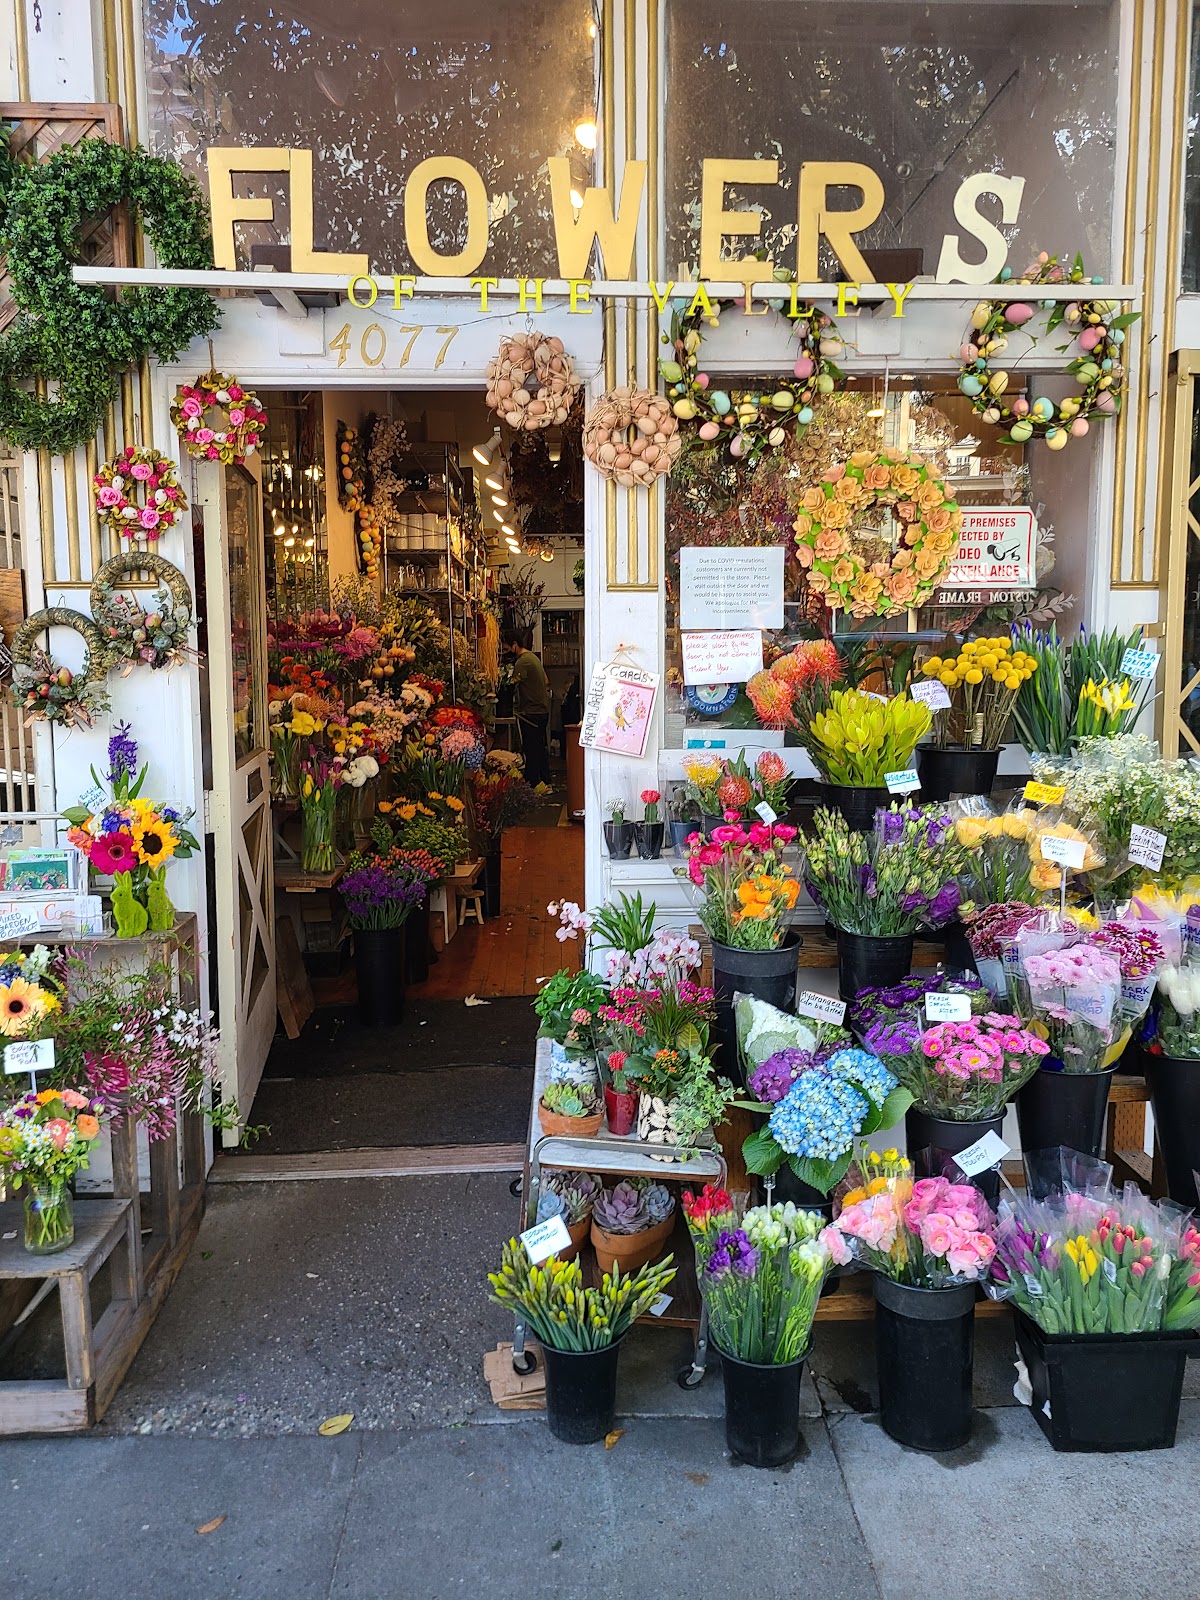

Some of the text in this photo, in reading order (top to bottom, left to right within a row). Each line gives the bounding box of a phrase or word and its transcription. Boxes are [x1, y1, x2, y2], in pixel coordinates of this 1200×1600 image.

[207, 147, 1026, 284] FLOWERS
[348, 274, 914, 318] OF THE VALLEY
[328, 323, 459, 368] 4077
[970, 518, 1016, 528] PREMISES
[992, 532, 1004, 540] BY
[734, 566, 758, 574] currently
